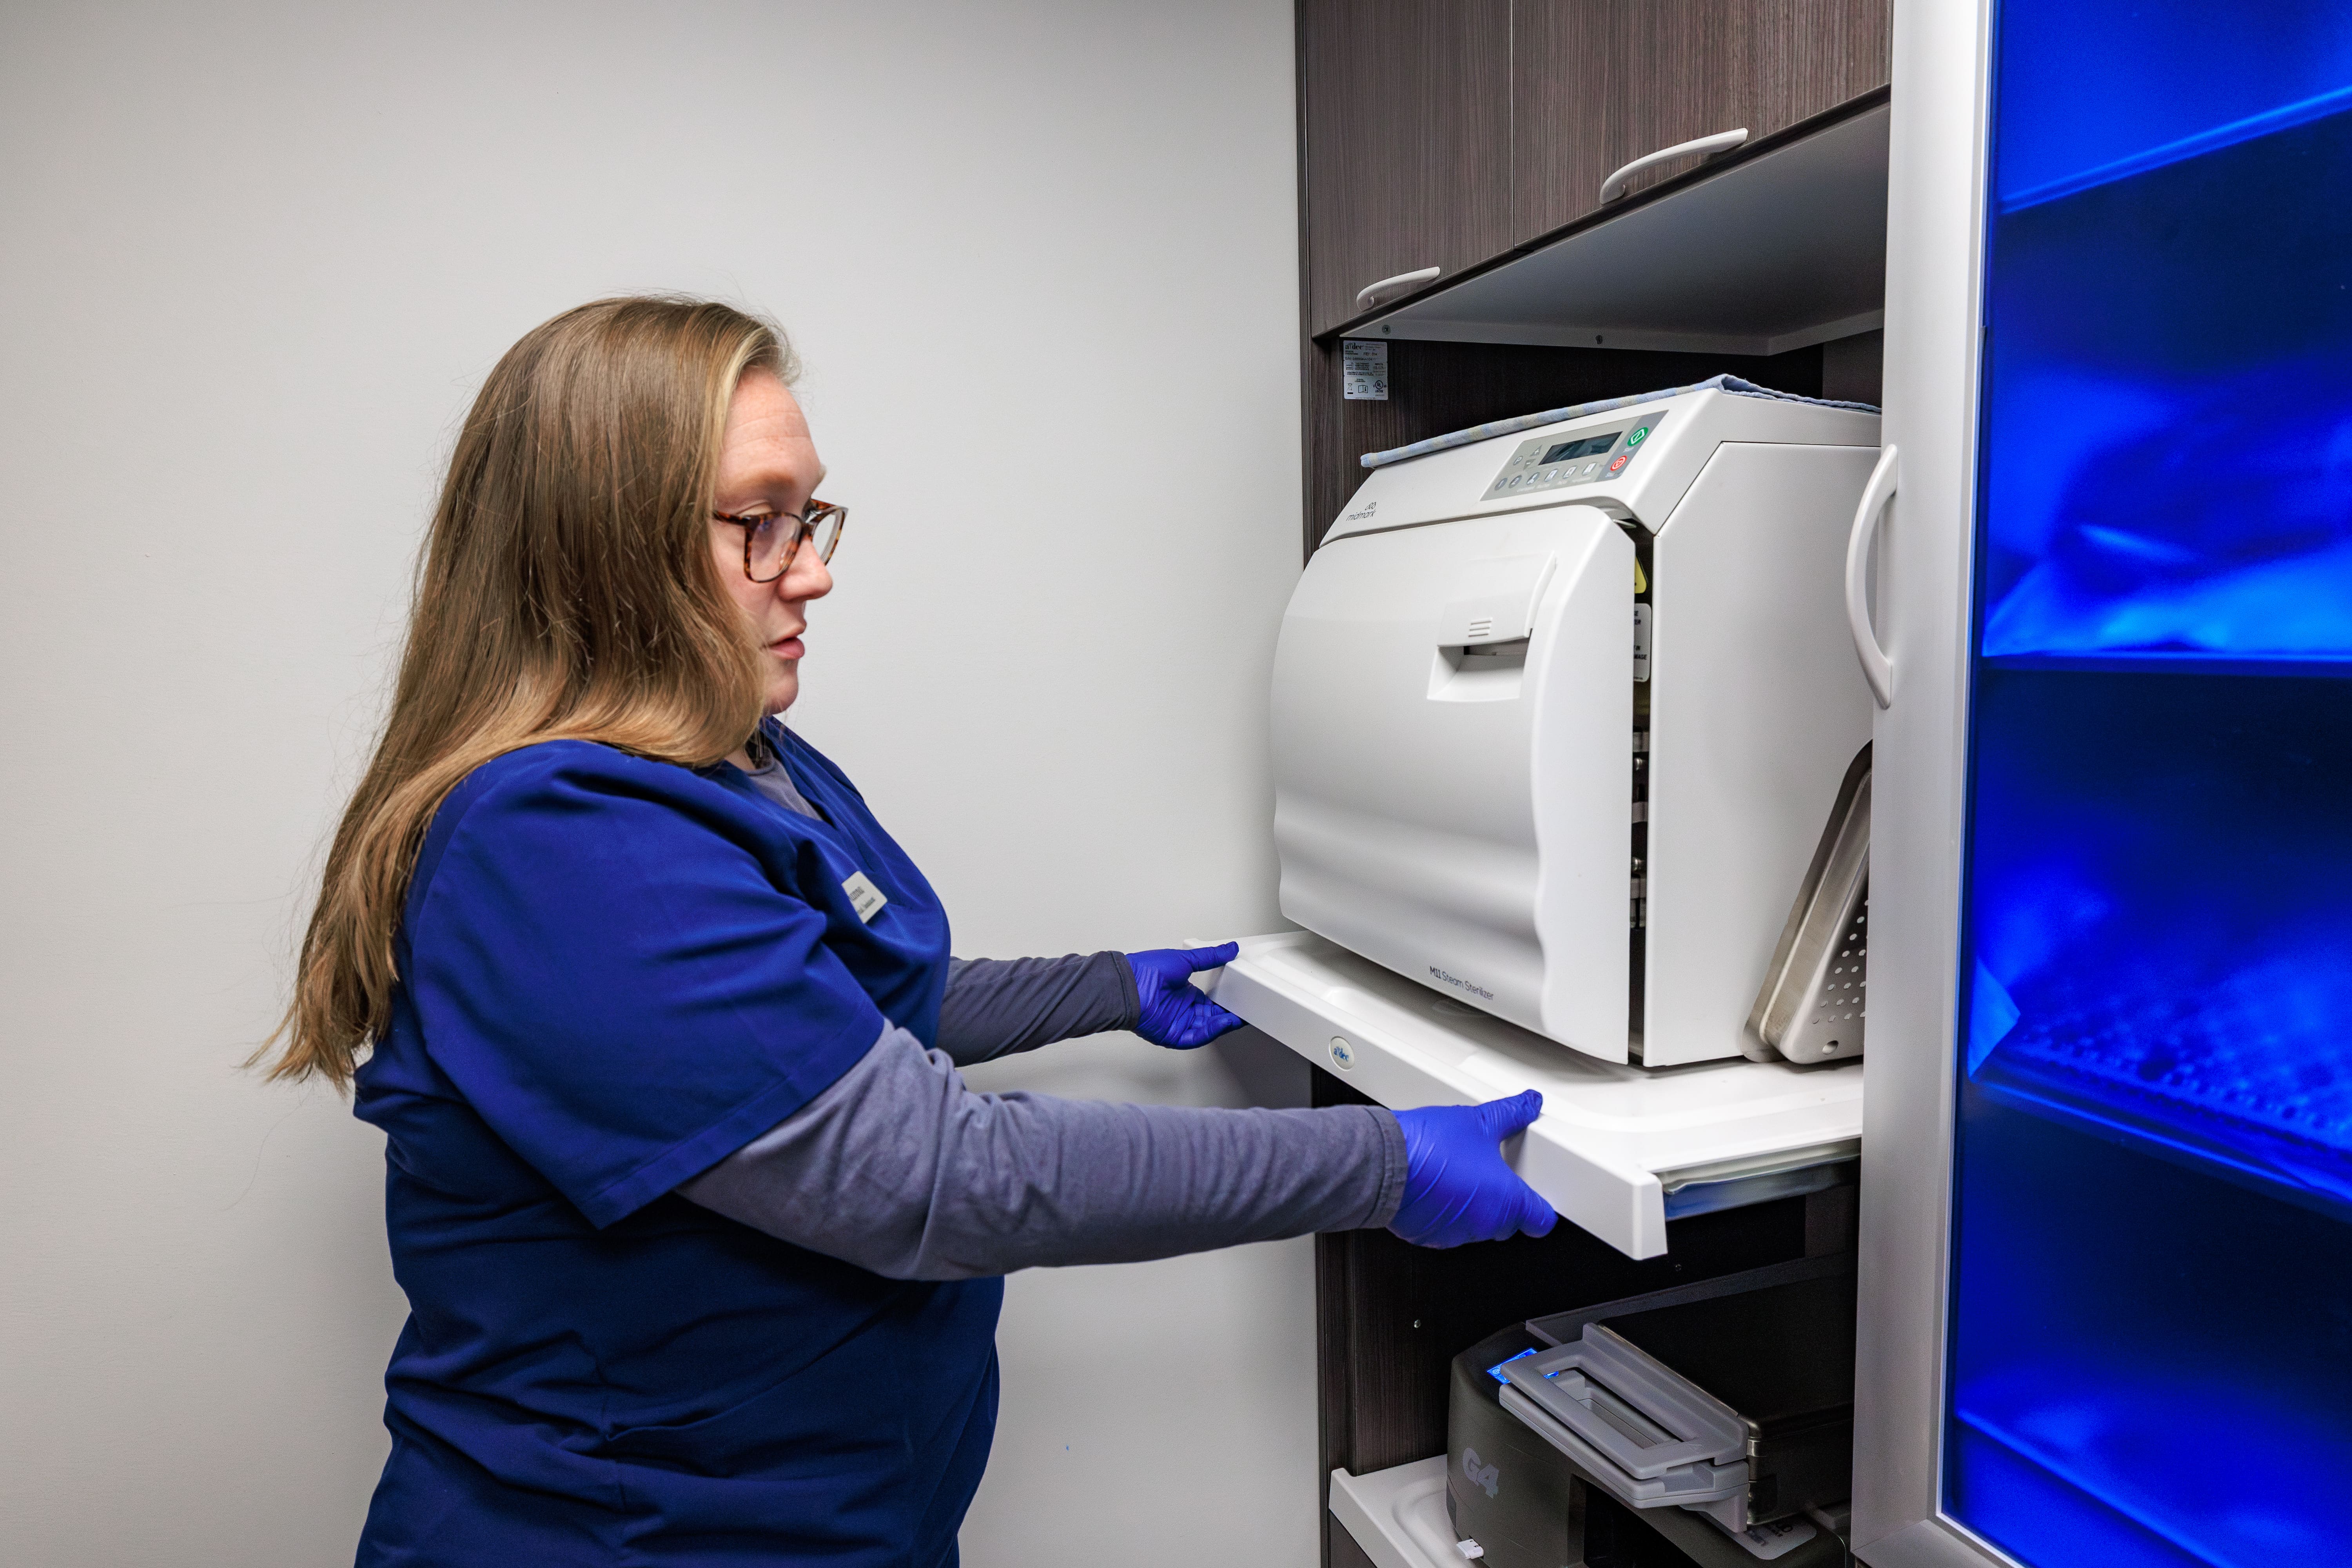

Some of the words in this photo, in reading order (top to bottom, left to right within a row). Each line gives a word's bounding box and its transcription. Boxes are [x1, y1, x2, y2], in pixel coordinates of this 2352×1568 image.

[1346, 509, 1376, 521] midmark
[1442, 971, 1464, 988] Steam
[1465, 981, 1494, 1000] Sterilizer
[1462, 1448, 1499, 1499] G4
